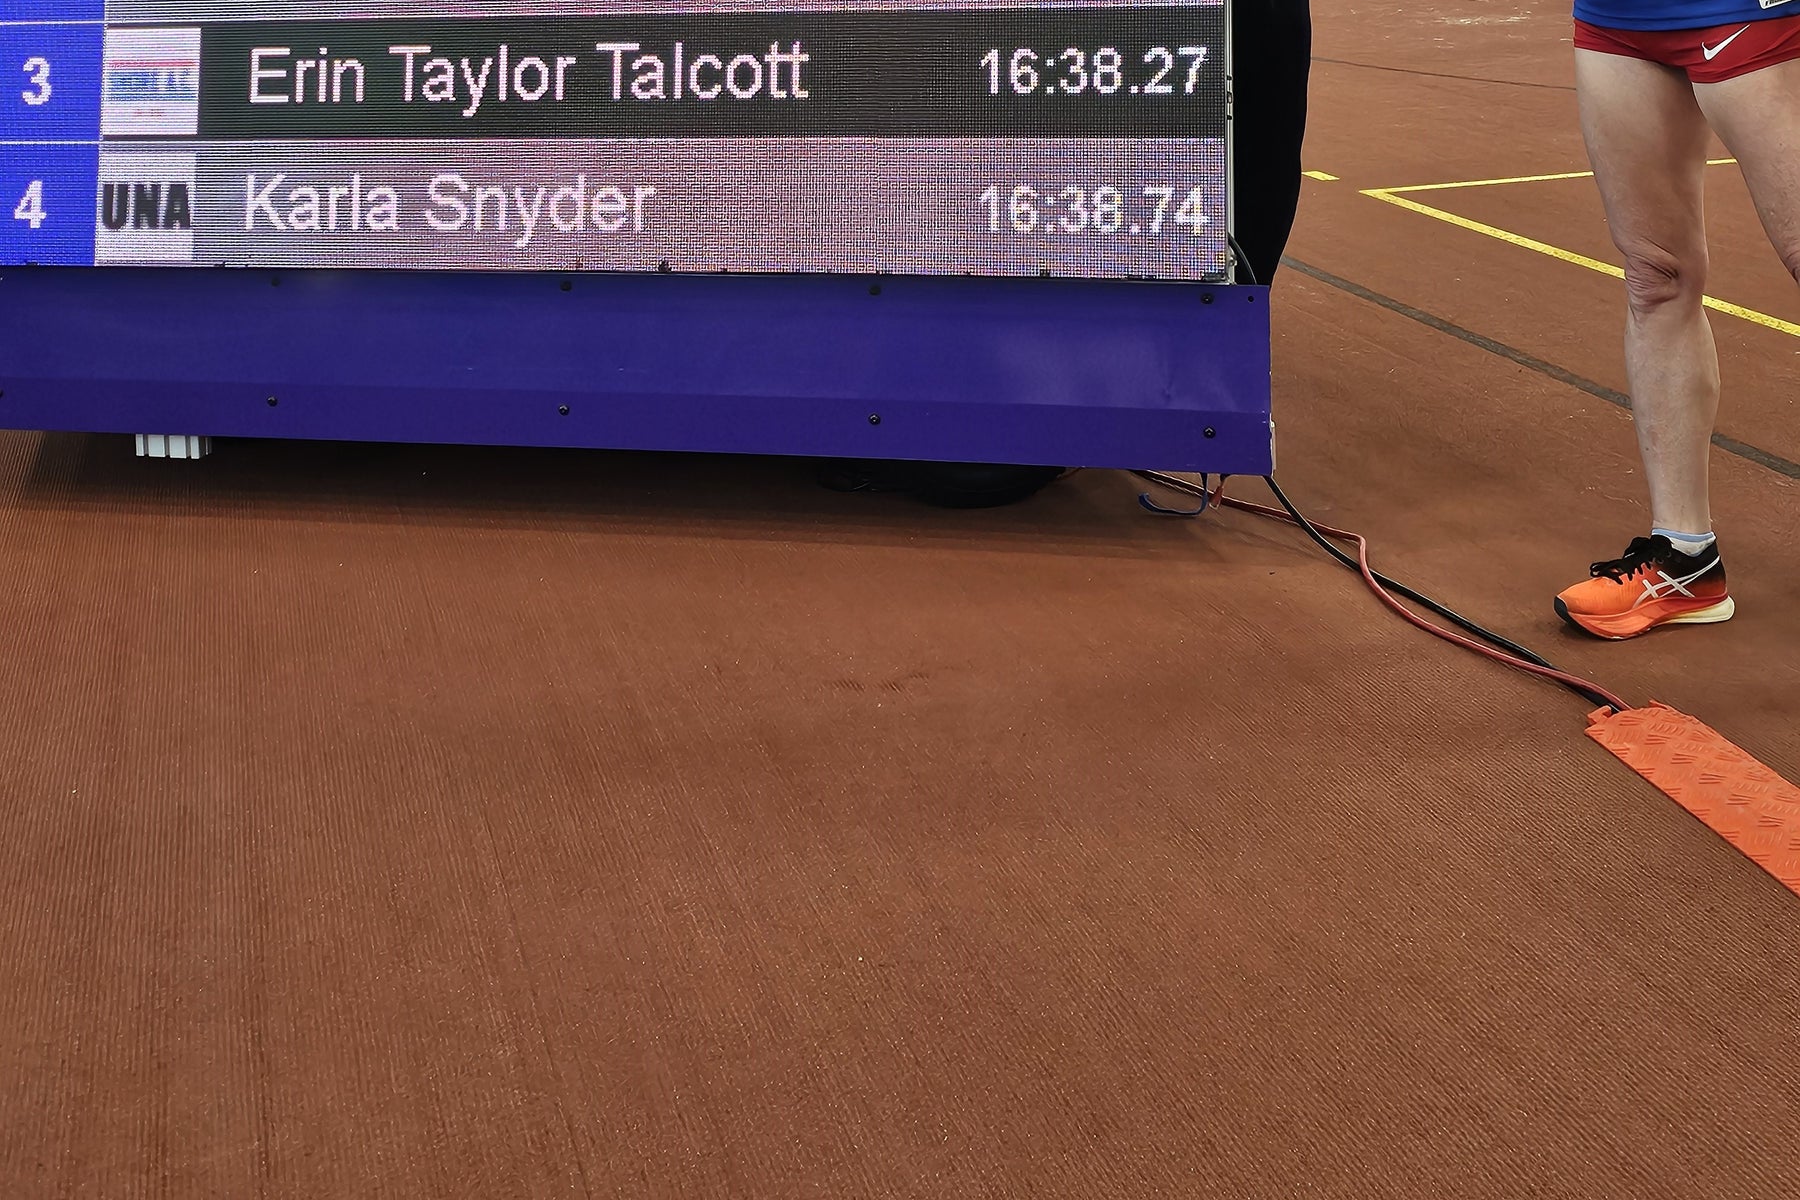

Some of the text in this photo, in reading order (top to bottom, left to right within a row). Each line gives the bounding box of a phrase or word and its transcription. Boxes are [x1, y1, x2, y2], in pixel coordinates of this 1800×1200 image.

[22, 57, 52, 106] 3
[249, 46, 366, 104] Erin
[389, 44, 576, 117] Taylor
[597, 40, 810, 102] Talcott
[980, 47, 1207, 95] 16:38.27
[14, 173, 1208, 249] 4 UNA Karla Snyder 16:38.74
